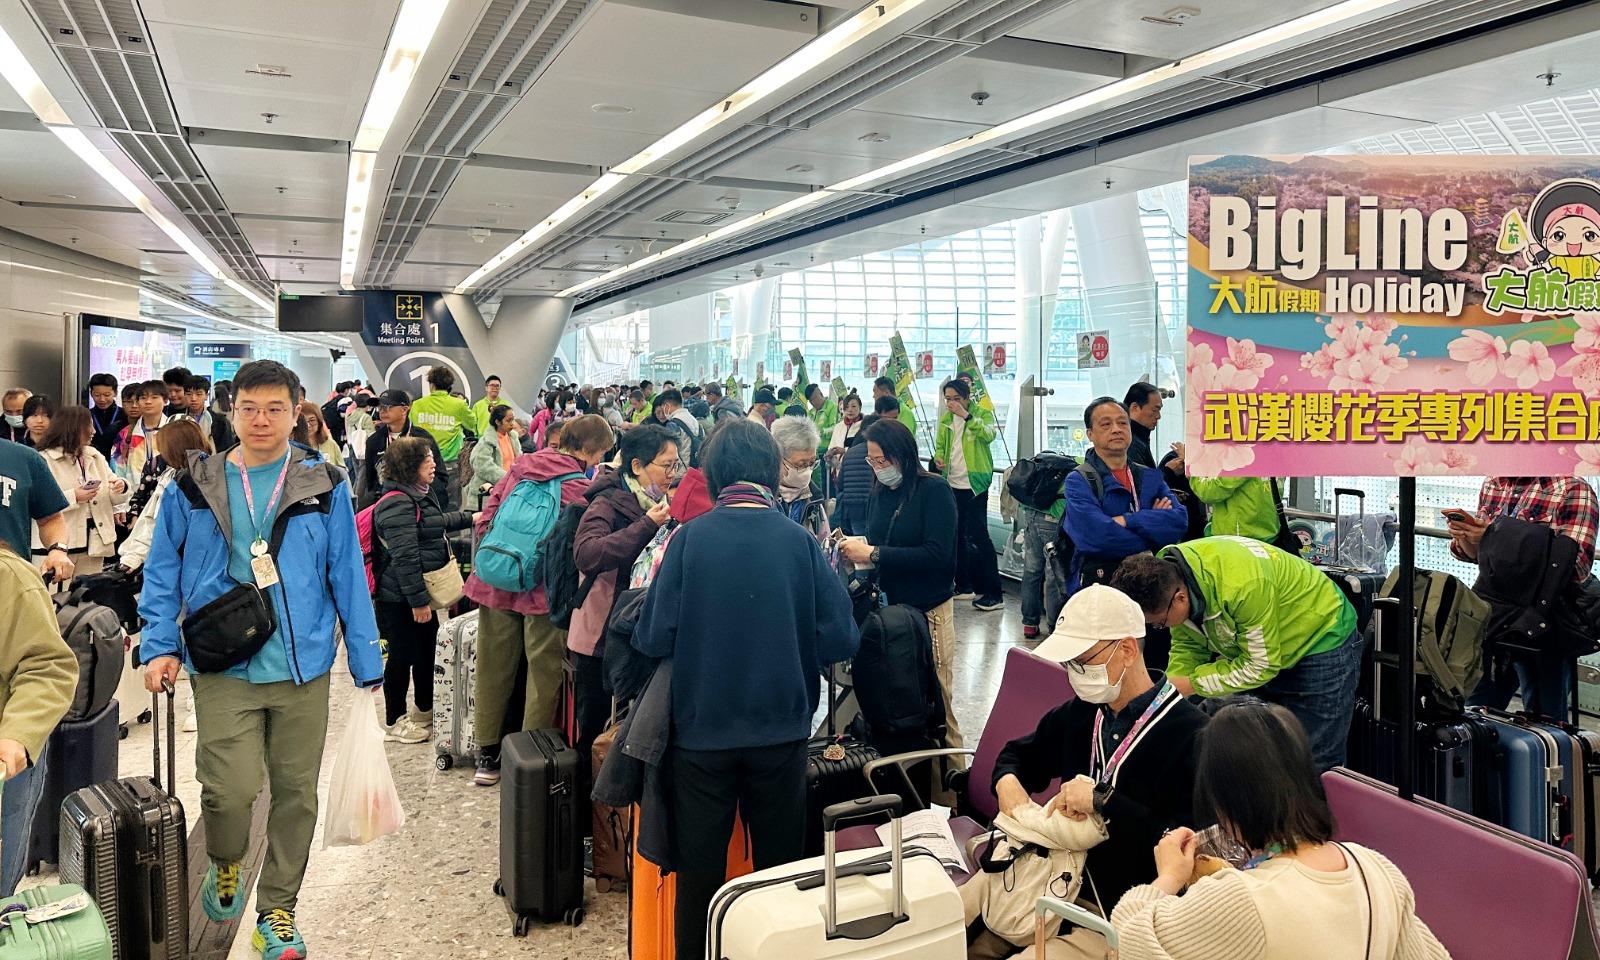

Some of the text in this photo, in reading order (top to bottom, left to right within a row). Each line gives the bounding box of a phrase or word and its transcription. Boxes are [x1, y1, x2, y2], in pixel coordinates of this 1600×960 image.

[1563, 206, 1584, 216] 大航
[1209, 196, 1468, 280] BigLine
[1508, 222, 1519, 245] 大航
[1208, 276, 1321, 315] 大航假期
[1325, 277, 1466, 317] Holiday
[377, 336, 425, 345] Meeting Point
[380, 322, 439, 344] 集合處 1
[1203, 391, 1600, 442] 武漢櫻花季專列集合
[0, 475, 17, 508] F
